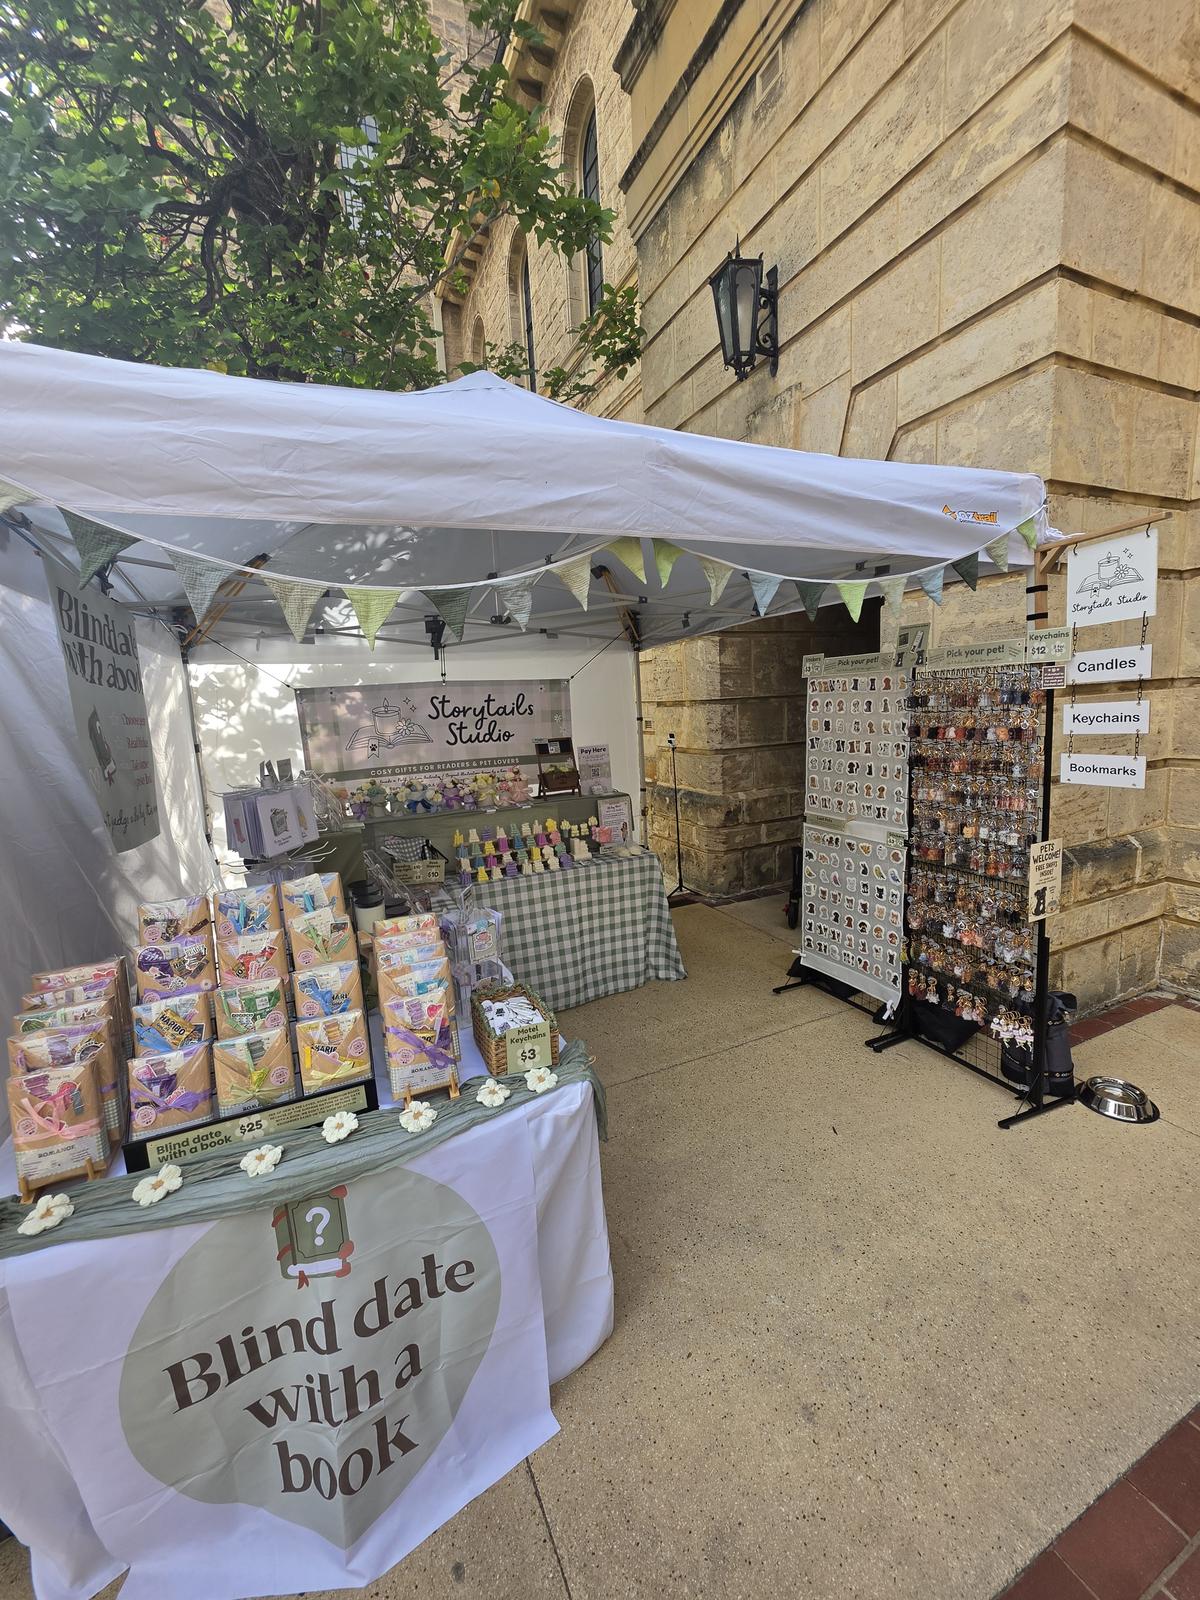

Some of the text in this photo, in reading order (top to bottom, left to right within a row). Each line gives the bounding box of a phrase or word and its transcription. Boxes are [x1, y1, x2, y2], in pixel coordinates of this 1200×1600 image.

[1071, 592, 1149, 614] Storytails Studio
[1029, 630, 1070, 642] Keychains
[946, 645, 1005, 658] Pick your pet!
[1031, 646, 1046, 656] $12
[851, 658, 864, 667] your
[866, 656, 879, 665] pet!
[1077, 657, 1136, 673] Candles
[428, 693, 534, 730] Storytails
[1072, 711, 1140, 726] Keychains
[446, 720, 515, 746] Studio
[395, 766, 418, 774] GIFTS
[420, 764, 435, 772] FOR
[437, 762, 471, 771] READERS
[480, 759, 492, 767] PET
[493, 757, 520, 766] LOVERS
[1069, 762, 1137, 777] Bookmarks
[1032, 849, 1061, 865] WELCOME!
[1040, 844, 1055, 854] PETS
[1035, 863, 1046, 872] FREE
[160, 1014, 186, 1036] HARIBO
[517, 1025, 539, 1036] Motel
[510, 1032, 547, 1044] Keychains
[520, 1048, 537, 1063] $3
[156, 1138, 190, 1155] Blind
[191, 1129, 222, 1145] date
[239, 1120, 263, 1135] $25
[157, 1134, 233, 1164] with a book
[163, 1254, 475, 1414] Blind date
[243, 1343, 423, 1428] with a
[272, 1414, 419, 1500] book
